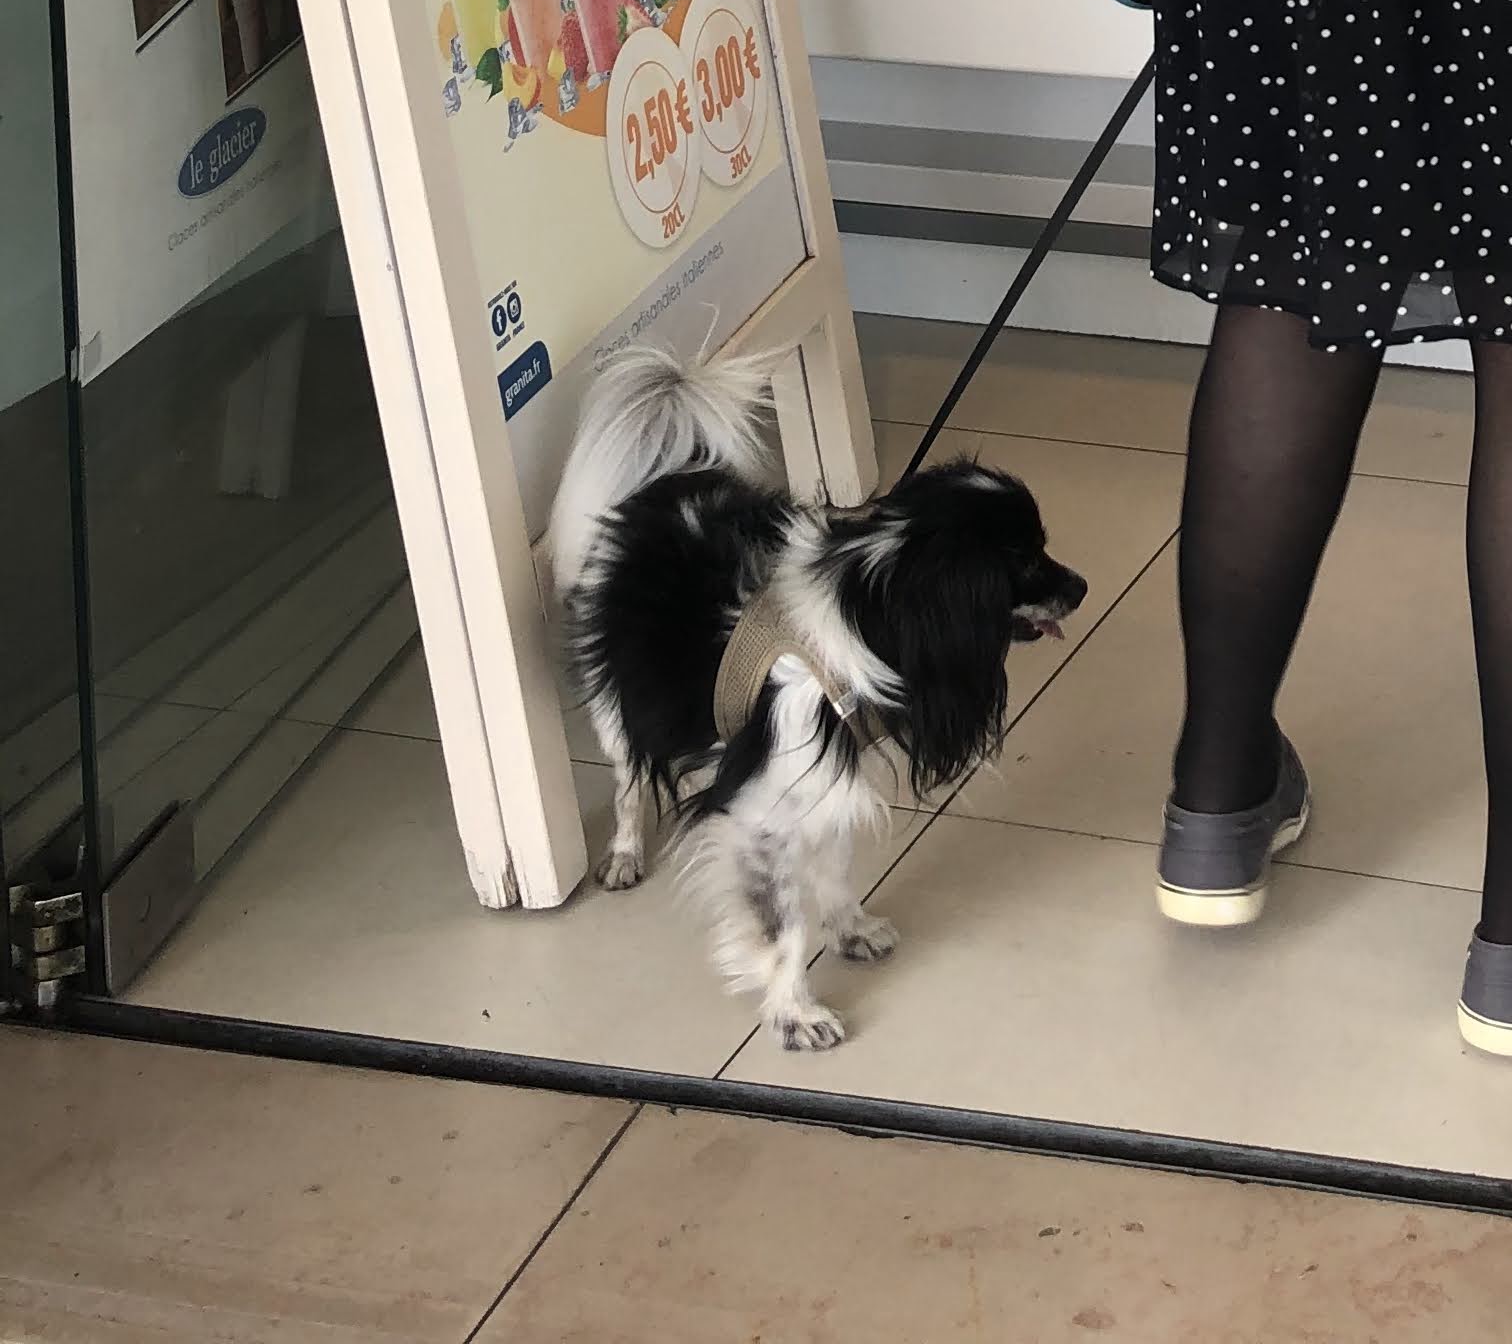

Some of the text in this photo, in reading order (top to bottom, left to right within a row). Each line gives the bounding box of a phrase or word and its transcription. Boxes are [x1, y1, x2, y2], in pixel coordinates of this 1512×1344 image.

[695, 27, 761, 125] 3,00 €
[189, 120, 257, 190] le glacier
[625, 78, 694, 185] 2,50 €
[661, 201, 687, 240] 20CL
[631, 280, 681, 338] artisanales
[681, 242, 725, 292] italiennes
[504, 358, 542, 408] granita.fr
